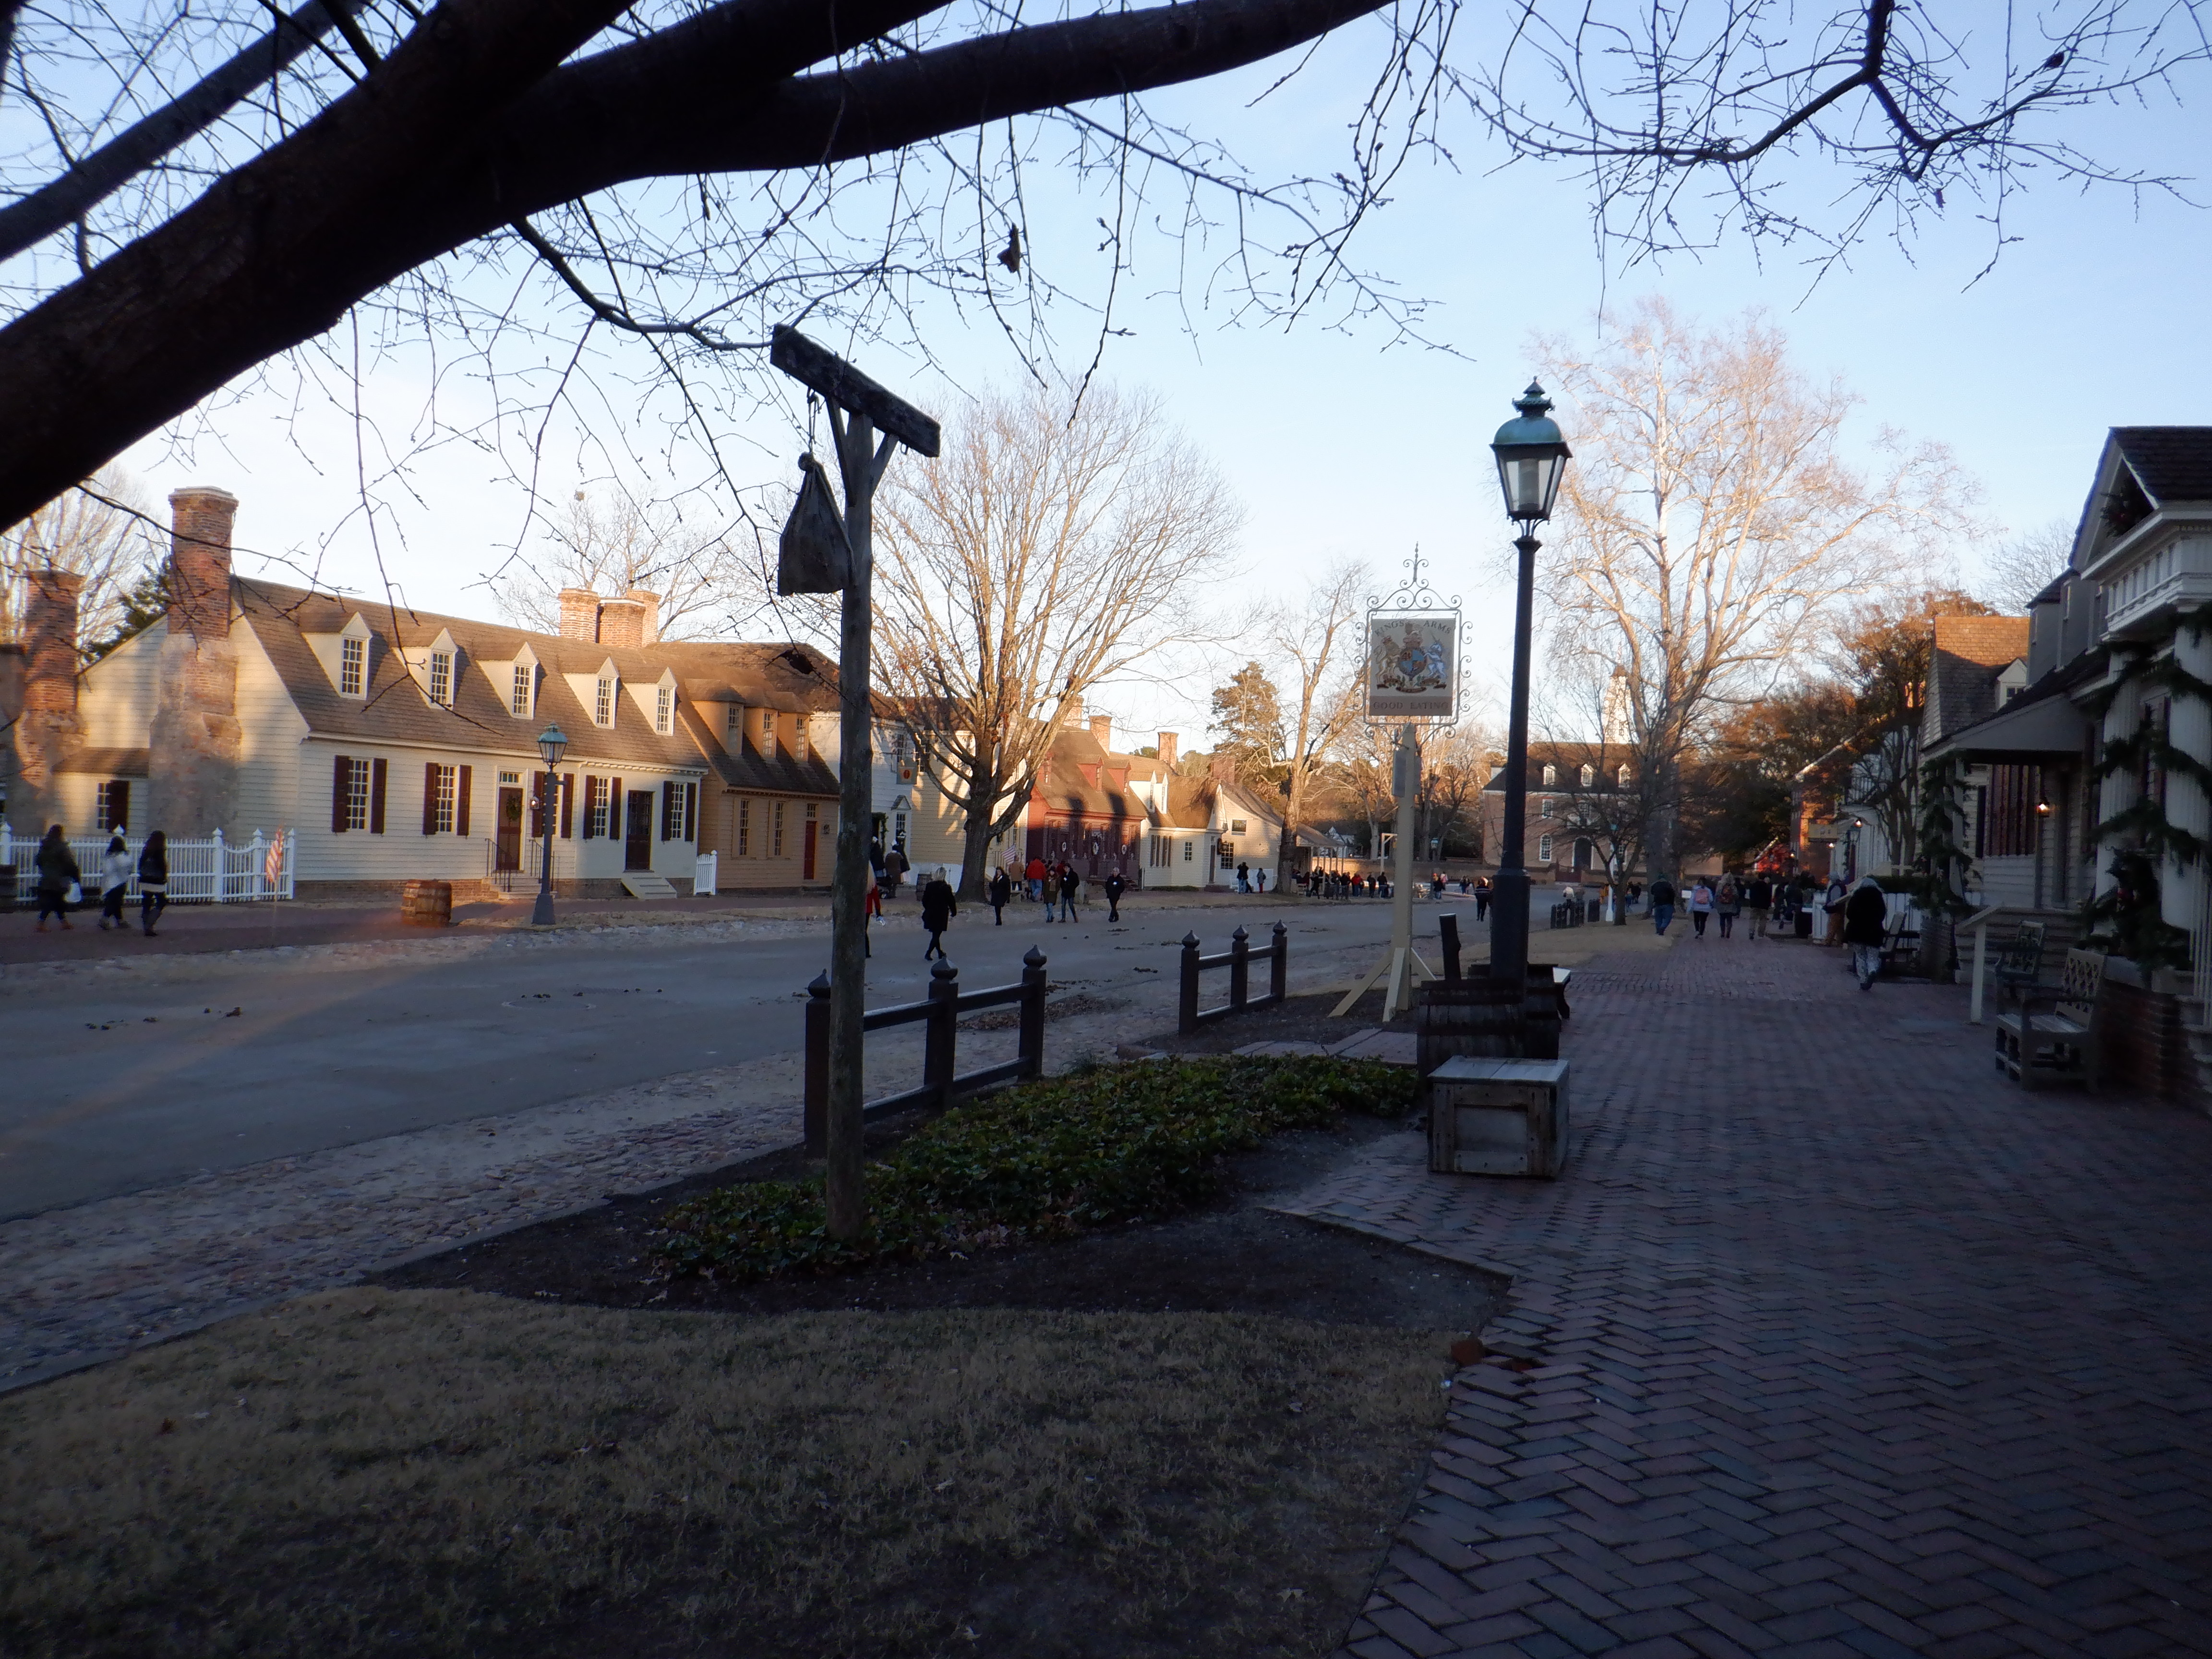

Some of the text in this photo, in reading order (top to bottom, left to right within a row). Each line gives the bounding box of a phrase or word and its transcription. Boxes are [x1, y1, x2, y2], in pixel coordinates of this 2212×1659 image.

[1374, 620, 1451, 637] KINGS ARMS
[1410, 701, 1448, 709] EATING
